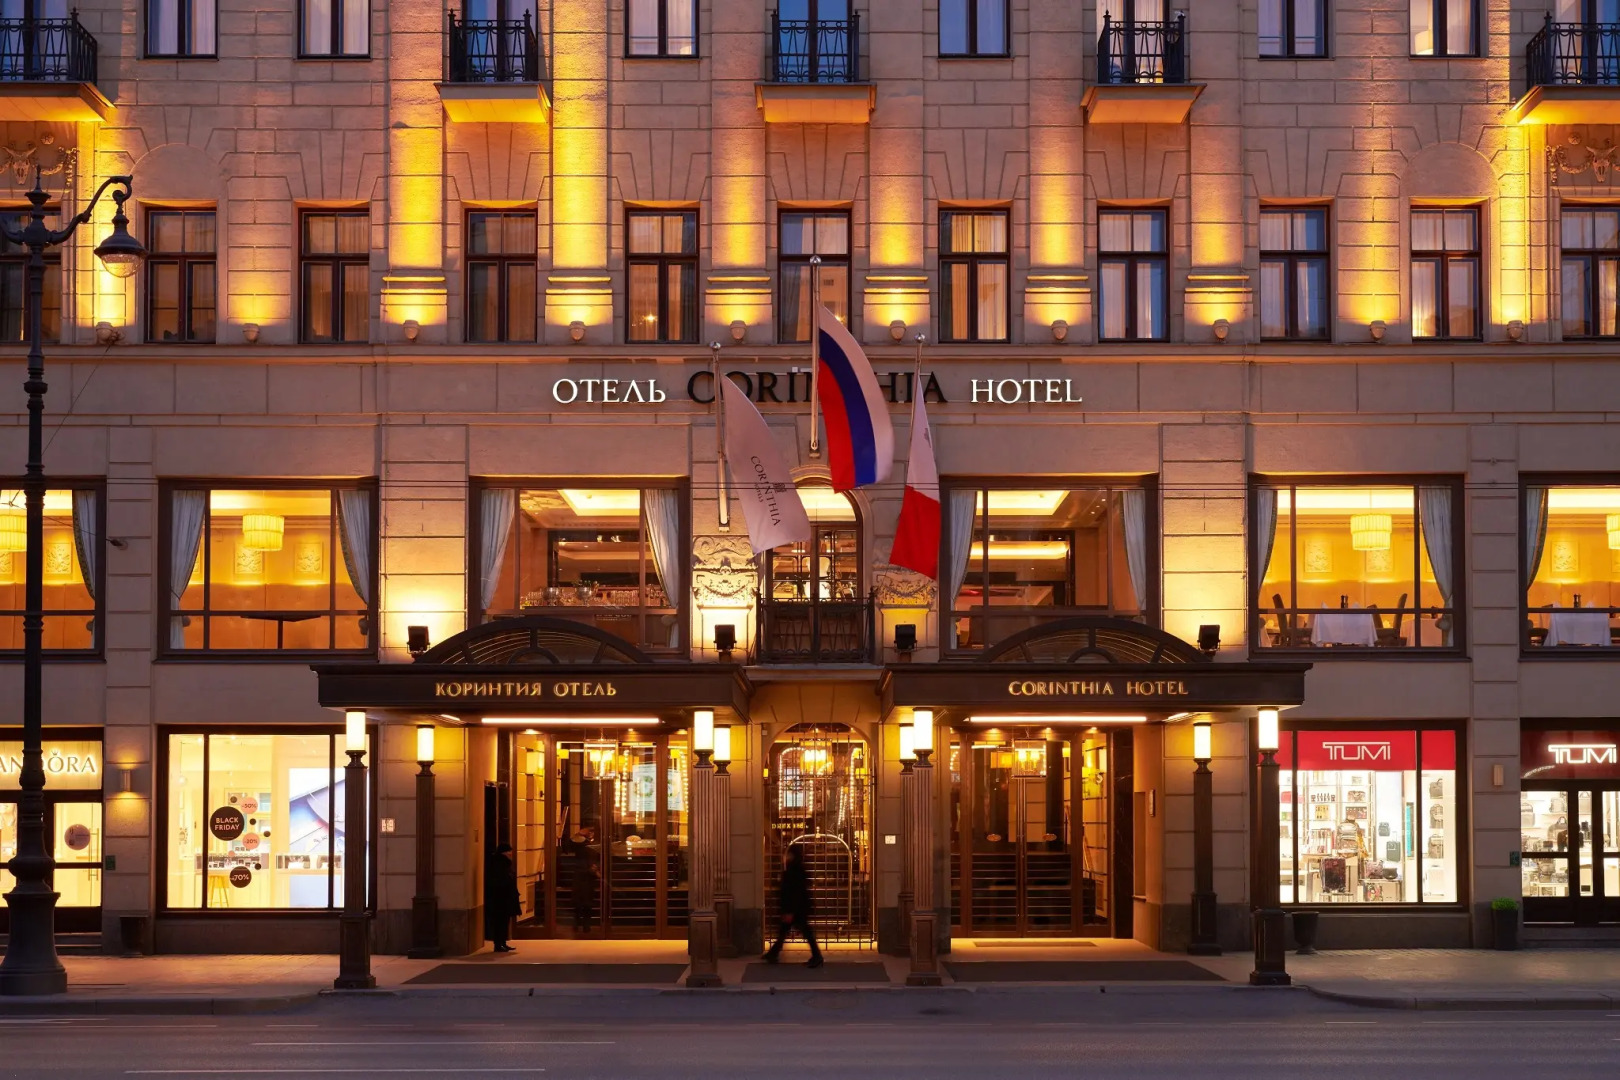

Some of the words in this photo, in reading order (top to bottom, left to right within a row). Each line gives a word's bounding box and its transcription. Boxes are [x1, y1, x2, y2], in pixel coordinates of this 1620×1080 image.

[552, 378, 666, 403] ОТЕЛЬ
[687, 371, 947, 403] CORIHIA
[970, 378, 1082, 403] HOTEL
[751, 456, 781, 526] CORINTHIA
[435, 682, 542, 697] КОРИНТИЯ
[553, 682, 616, 697] ОТЕЛЬ
[1008, 681, 1114, 696] CORINTHIA
[1126, 681, 1189, 696] HOTEL
[1322, 741, 1391, 760] TUMI
[1547, 743, 1617, 764] TUMI
